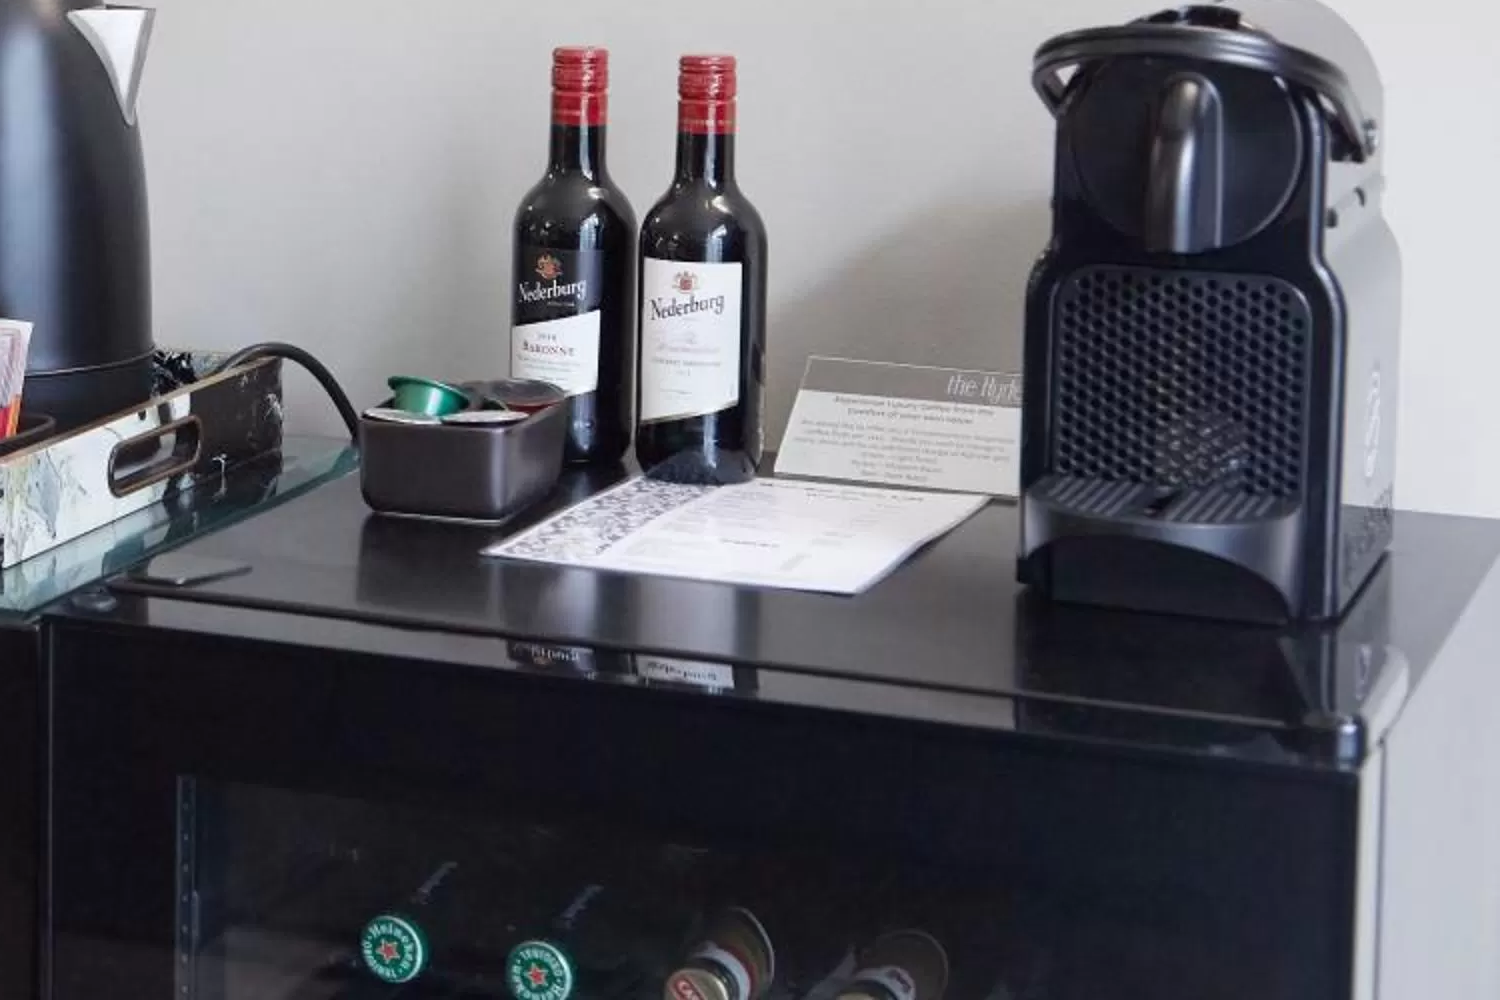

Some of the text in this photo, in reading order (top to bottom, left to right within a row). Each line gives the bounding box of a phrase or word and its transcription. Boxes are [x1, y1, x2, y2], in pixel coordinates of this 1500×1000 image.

[519, 280, 588, 302] Nederburg
[650, 295, 725, 320] Nederburg
[946, 373, 979, 397] the
